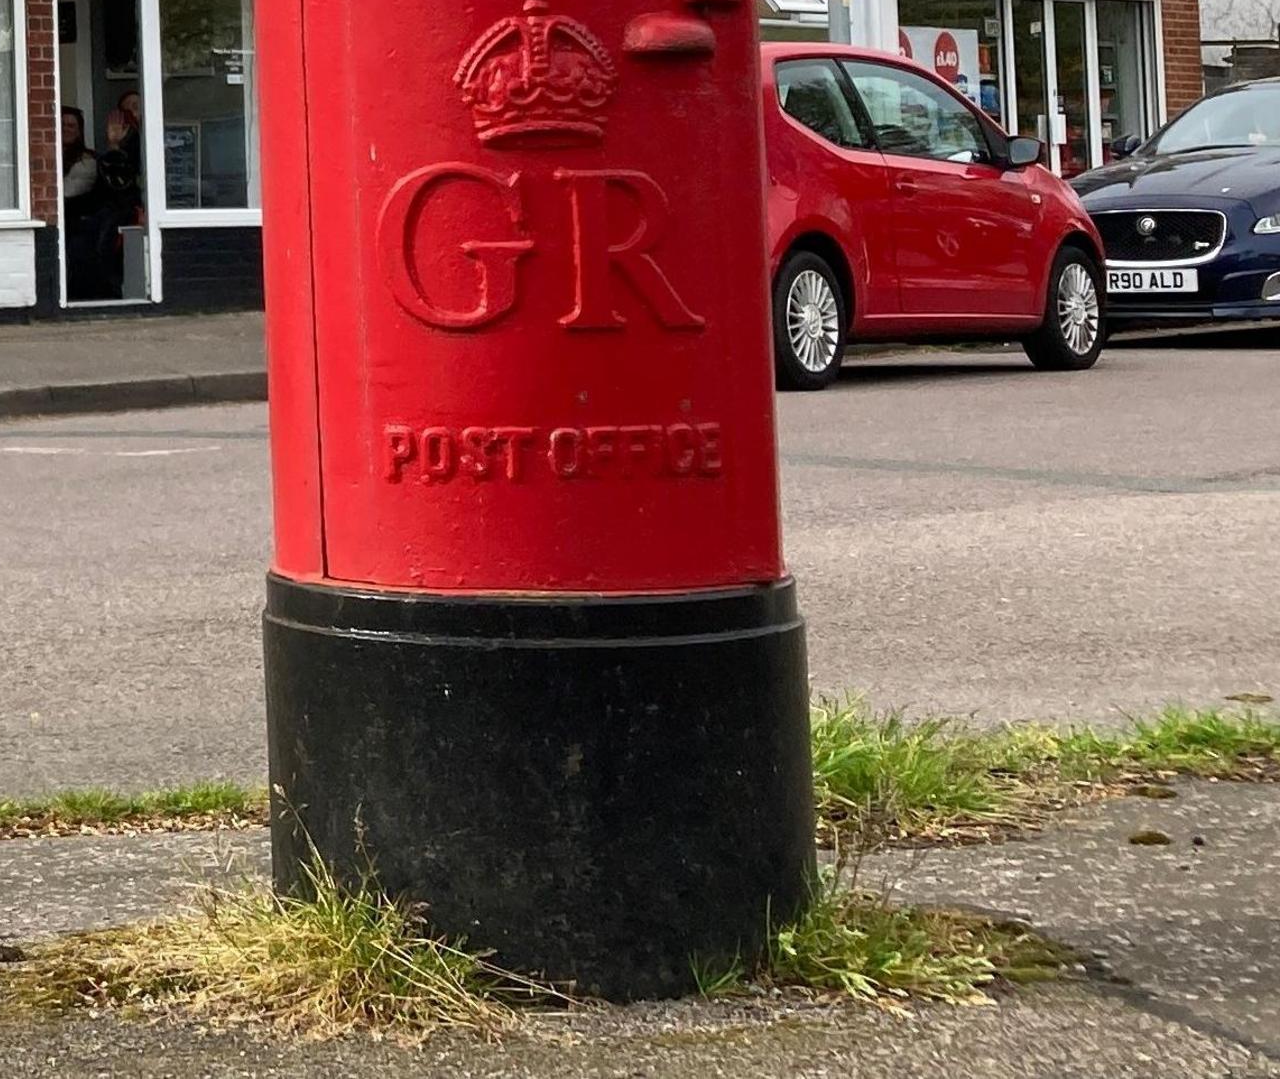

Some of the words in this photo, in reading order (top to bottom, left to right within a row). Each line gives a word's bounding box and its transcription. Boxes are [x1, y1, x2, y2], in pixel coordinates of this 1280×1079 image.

[374, 160, 707, 332] GR
[1109, 272, 1143, 289] R90
[1149, 272, 1184, 289] ALD
[382, 423, 538, 485] POST
[547, 422, 723, 479] OFFICE
